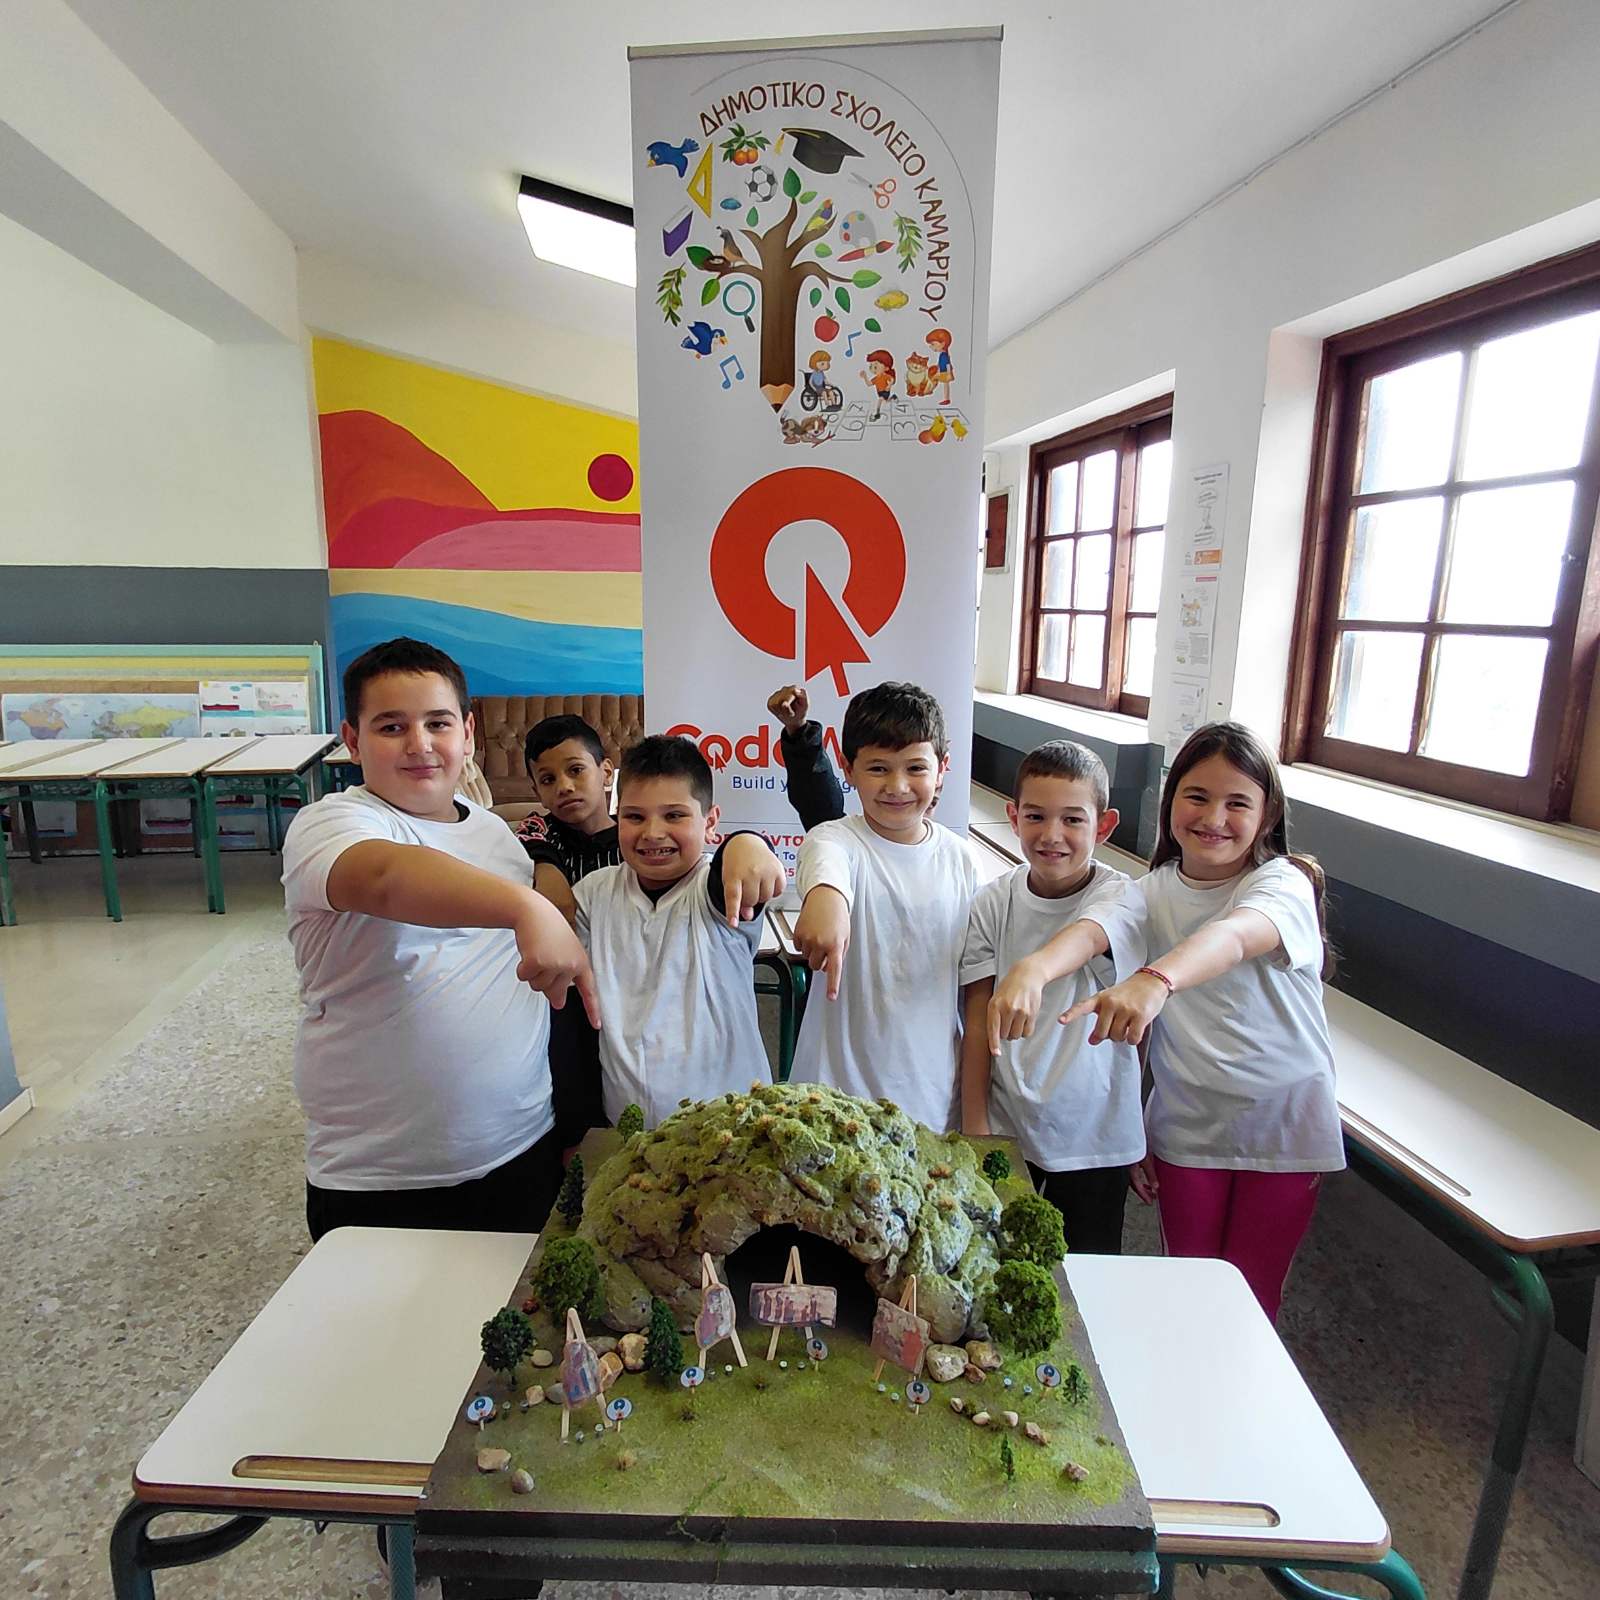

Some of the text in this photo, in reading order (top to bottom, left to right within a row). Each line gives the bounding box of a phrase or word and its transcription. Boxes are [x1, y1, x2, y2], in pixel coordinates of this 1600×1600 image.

[699, 81, 950, 323] ΔΗΜΟΤΙΚΟ ΣΧΟΛΕΙΟ ΚΑΜΑΡΙΟΥ
[733, 776, 775, 789] Build
